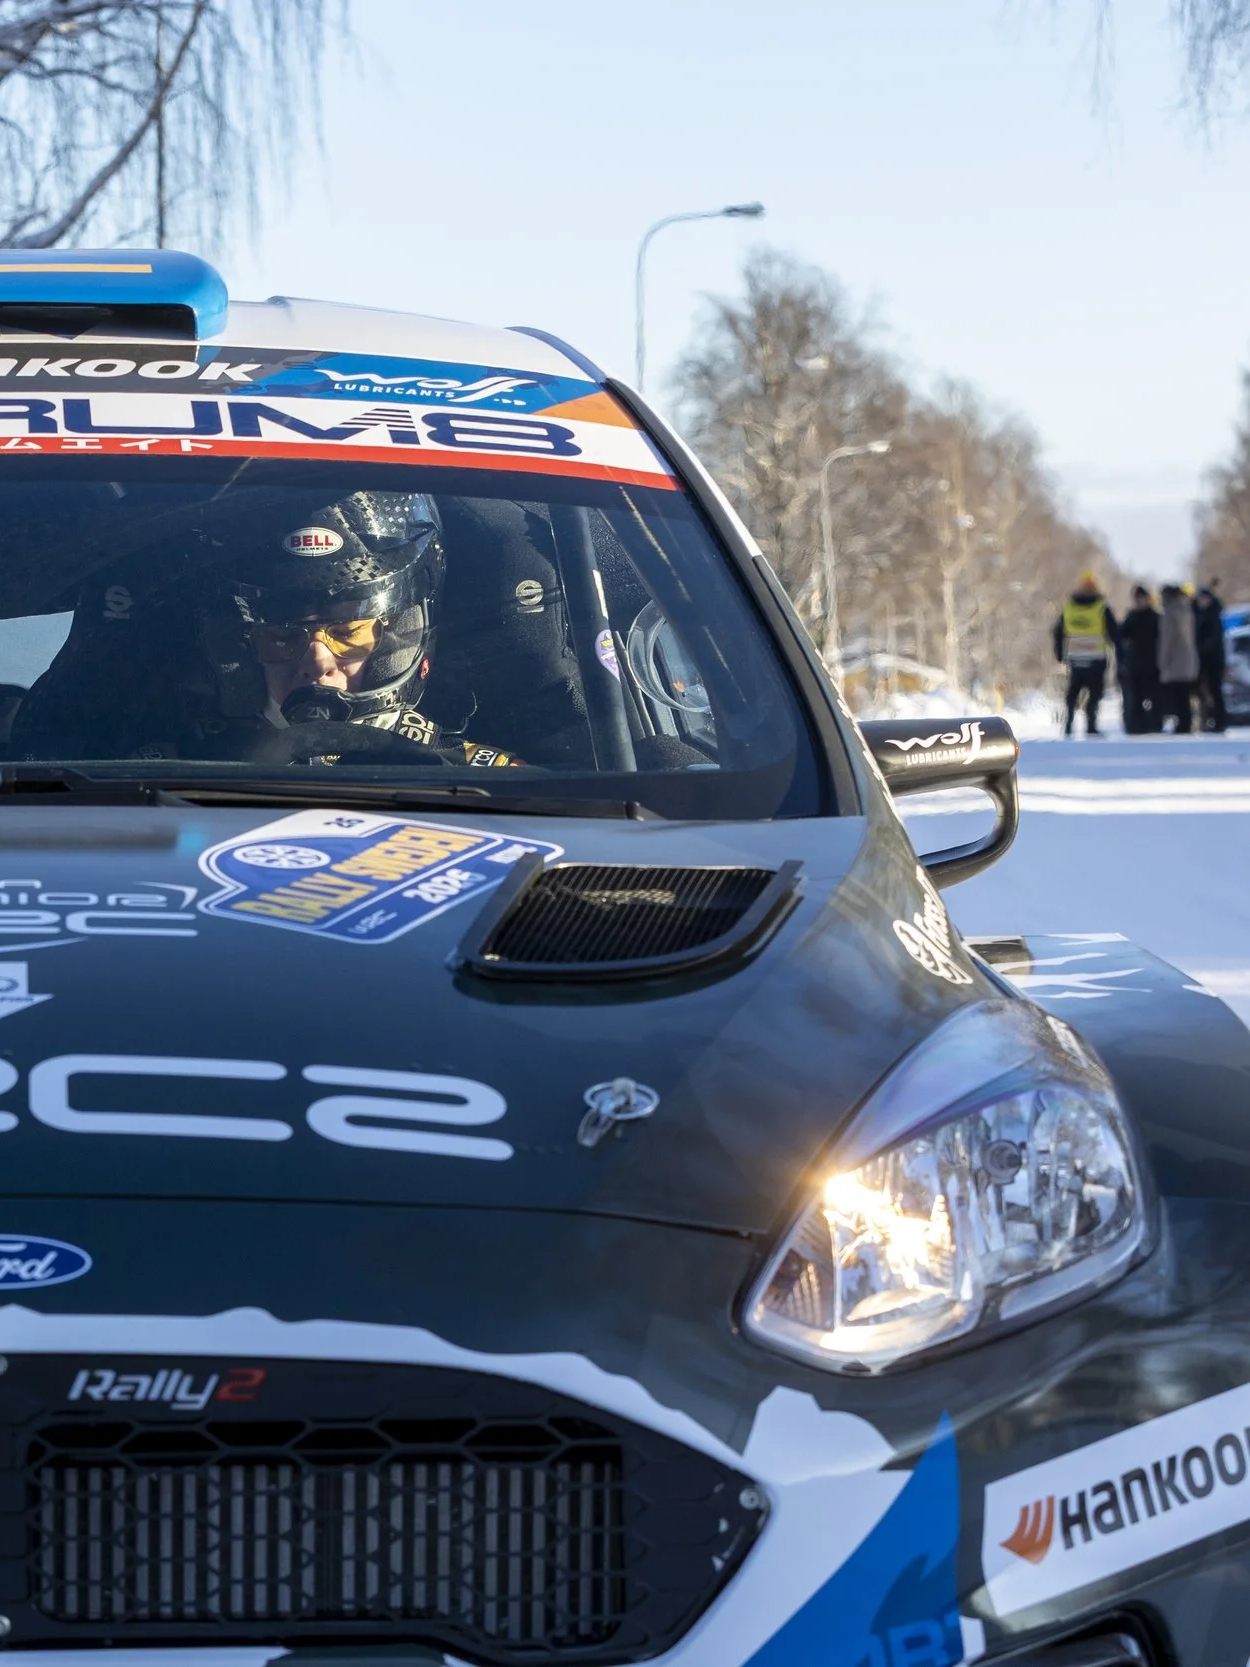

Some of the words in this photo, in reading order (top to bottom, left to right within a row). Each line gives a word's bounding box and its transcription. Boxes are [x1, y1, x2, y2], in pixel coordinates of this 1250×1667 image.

[333, 383, 456, 399] LUBRICANTS
[290, 534, 334, 547] BELL
[905, 747, 968, 766] LUBRICANTS
[230, 870, 379, 924] RALLY
[329, 825, 489, 881] SWEDEN
[67, 1368, 268, 1411] Rally2
